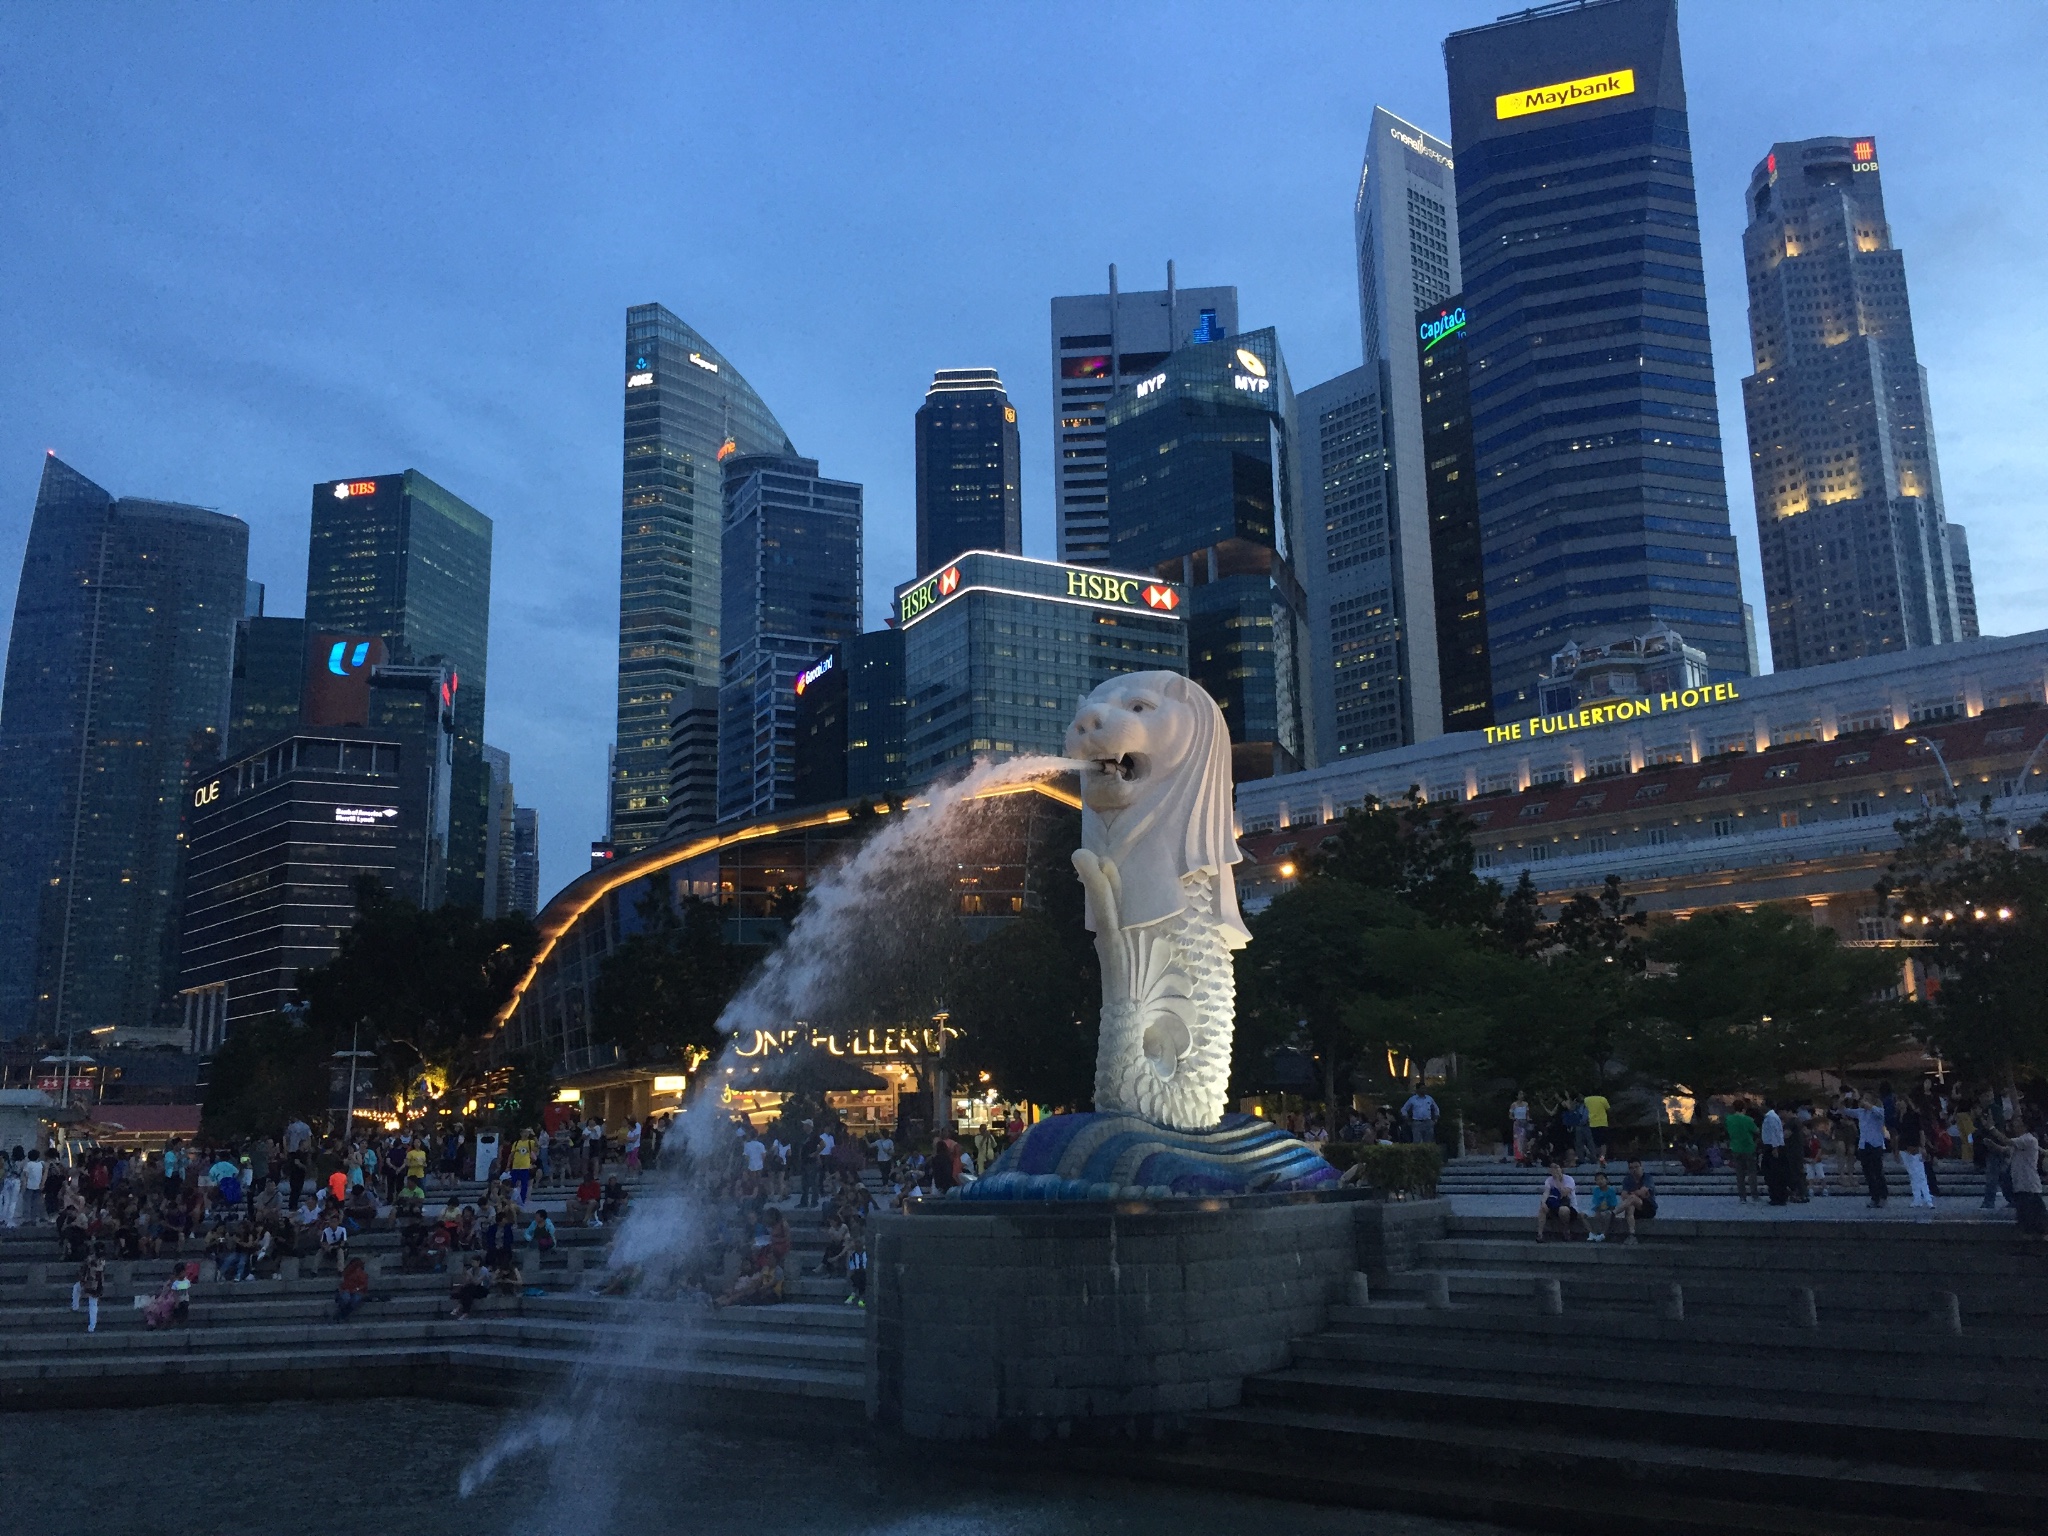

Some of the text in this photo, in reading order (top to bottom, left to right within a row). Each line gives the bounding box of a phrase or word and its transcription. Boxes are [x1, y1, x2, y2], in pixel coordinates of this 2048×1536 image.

[1525, 76, 1621, 108] Maybank
[1852, 161, 1879, 172] UOB
[1136, 373, 1167, 399] MYP
[1234, 374, 1270, 393] MYP
[349, 481, 376, 496] UBS
[901, 578, 938, 622] HSBC
[1066, 571, 1139, 605] HSBC
[1483, 682, 1739, 744] THE FULLERTON HOTEL
[194, 780, 220, 808] OUE
